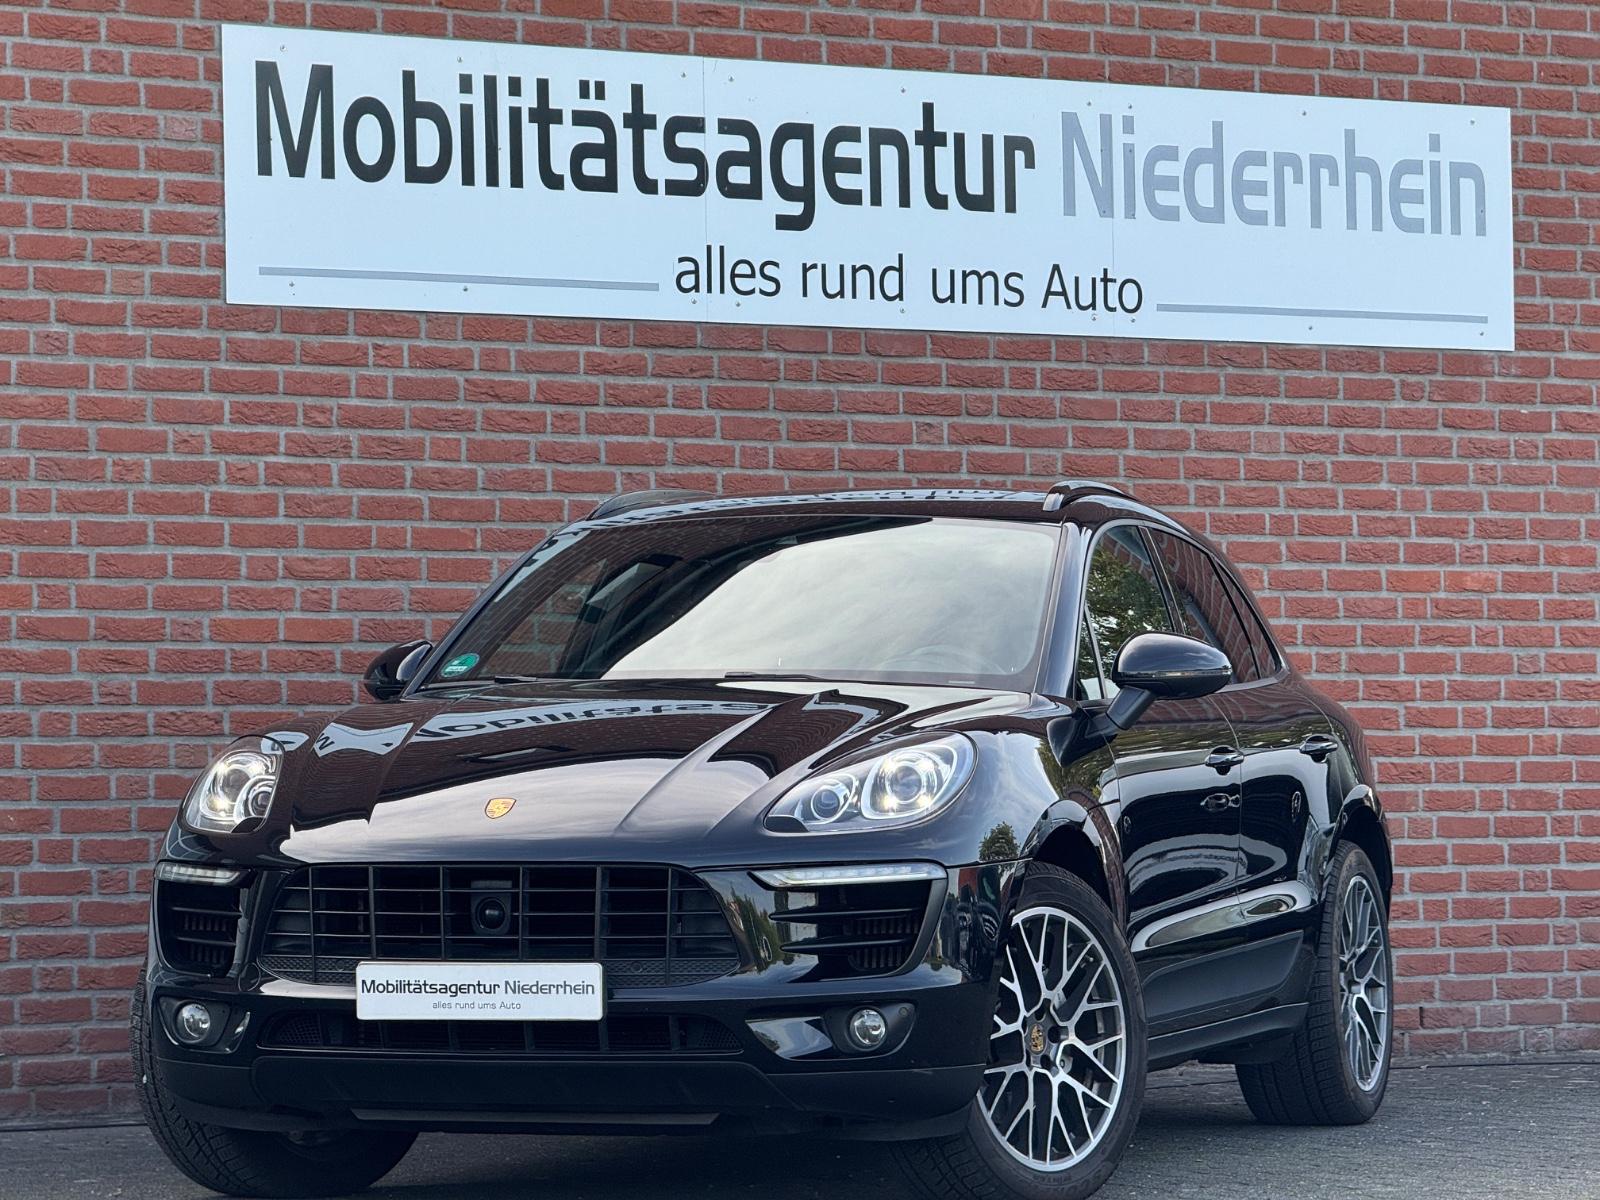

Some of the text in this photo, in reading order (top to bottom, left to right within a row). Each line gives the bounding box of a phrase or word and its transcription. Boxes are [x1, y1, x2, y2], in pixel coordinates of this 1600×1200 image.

[255, 60, 1487, 237] Mobilitätsagentur Niederrhein
[676, 245, 1144, 315] alles rund ums Auto
[361, 979, 595, 998] Mobilitätsagentur Niederrhein
[432, 1001, 452, 1009] alles
[455, 1001, 475, 1009] rund
[499, 1001, 522, 1010] Auto
